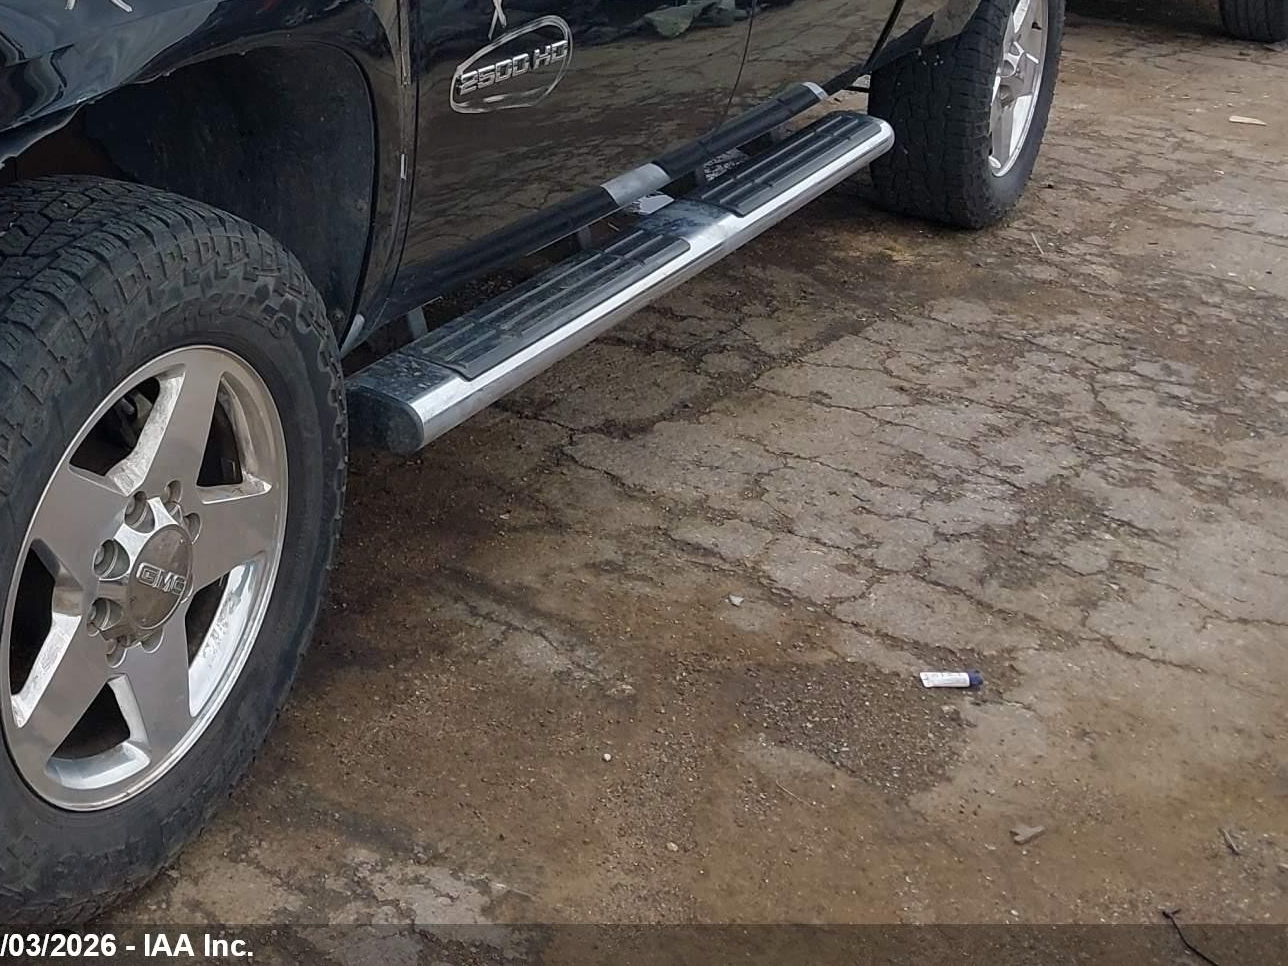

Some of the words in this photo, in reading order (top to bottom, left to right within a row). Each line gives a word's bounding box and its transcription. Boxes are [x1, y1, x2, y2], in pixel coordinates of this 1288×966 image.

[458, 53, 530, 96] 2500
[533, 39, 569, 70] HD
[135, 562, 187, 596] GMC
